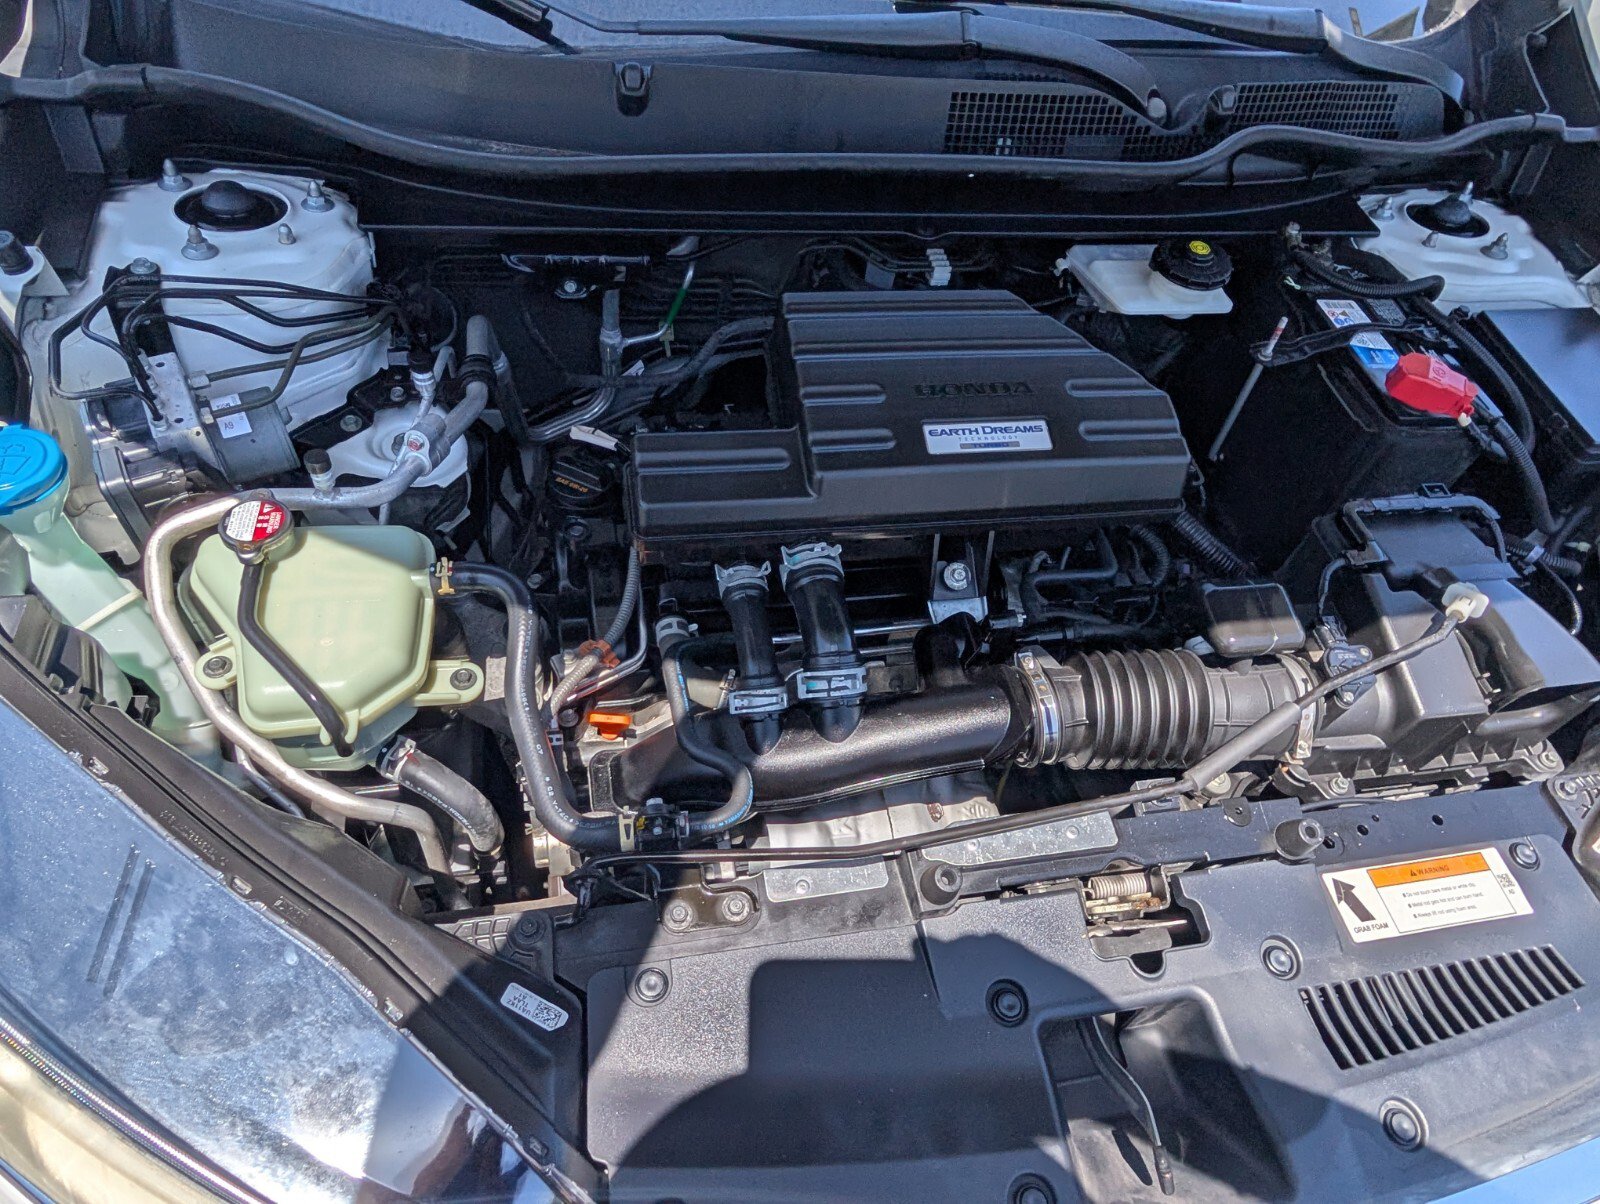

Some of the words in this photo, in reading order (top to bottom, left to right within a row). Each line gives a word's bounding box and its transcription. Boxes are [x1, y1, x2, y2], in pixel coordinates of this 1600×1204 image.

[913, 381, 1034, 398] HONDA
[928, 427, 979, 437] EARTH
[981, 425, 1044, 435] DREAMS
[1417, 864, 1450, 876] WARNING
[1353, 925, 1371, 934] GRAB
[1371, 922, 1389, 932] FOAM
